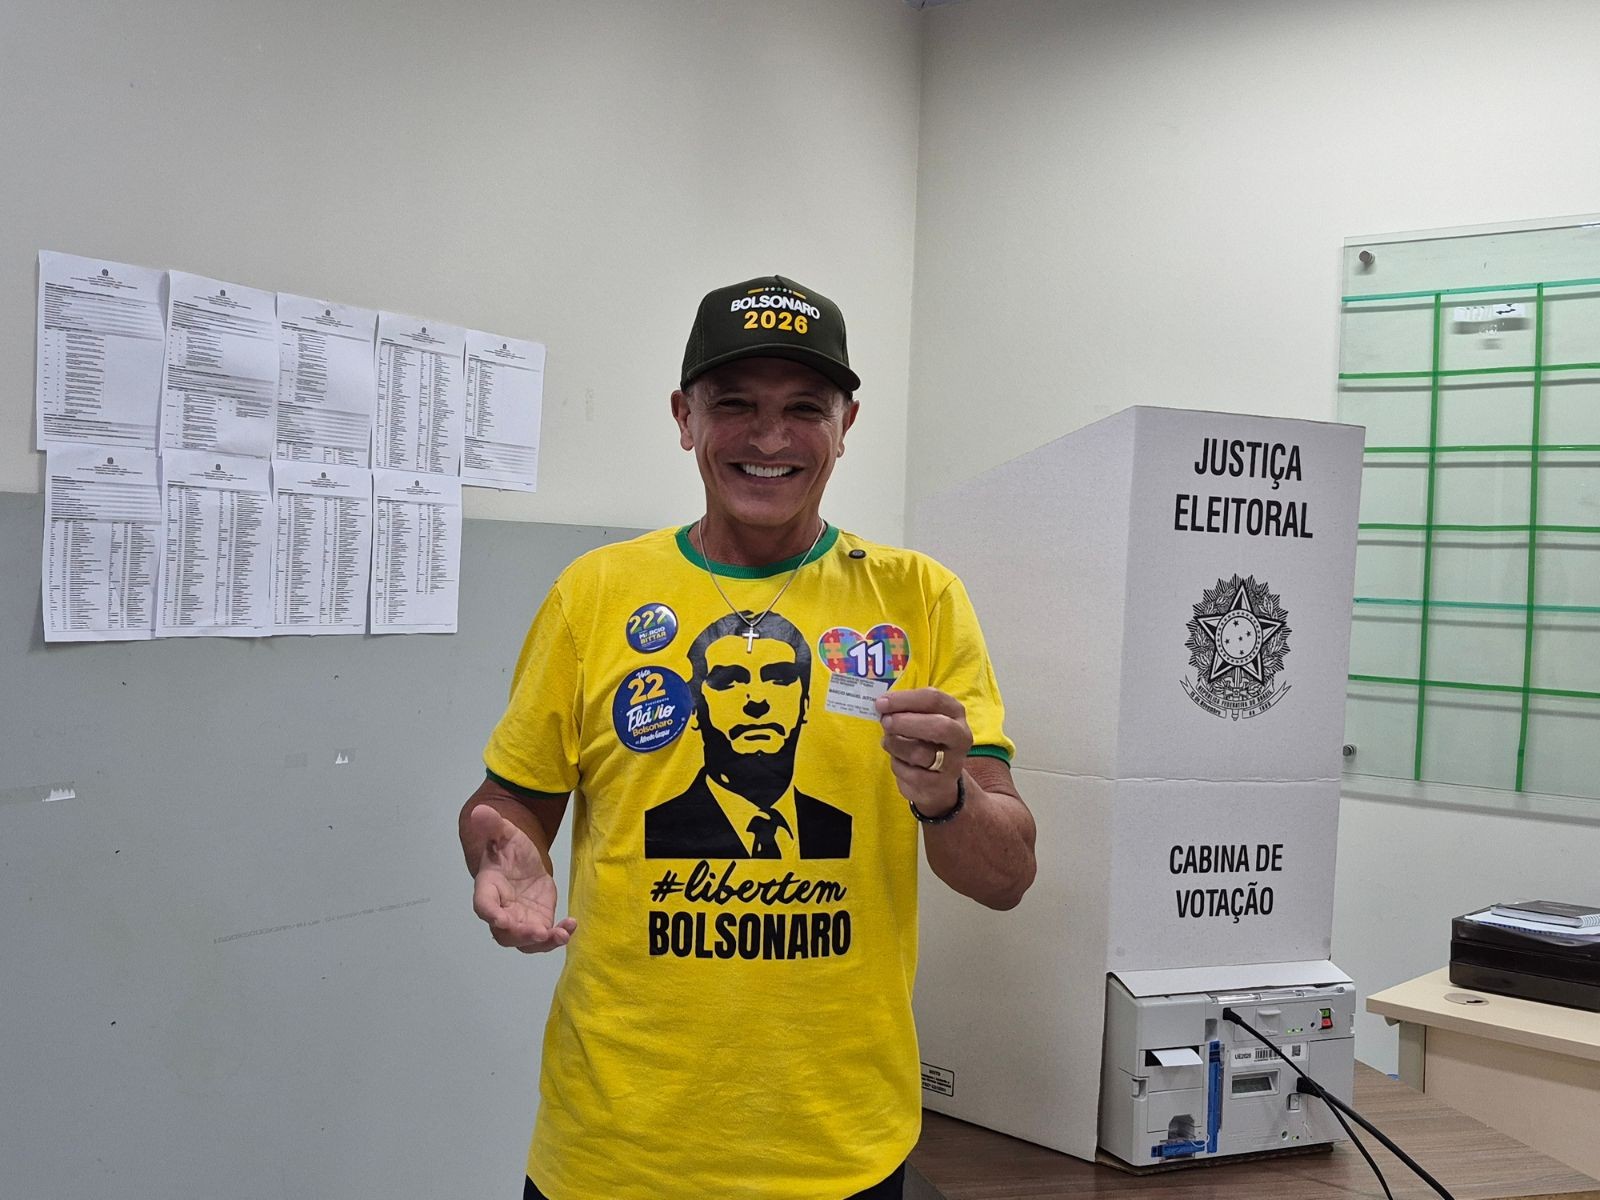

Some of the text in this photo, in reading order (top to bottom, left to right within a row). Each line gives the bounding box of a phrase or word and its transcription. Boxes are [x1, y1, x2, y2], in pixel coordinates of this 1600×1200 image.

[730, 295, 820, 319] BOLSONARO
[744, 310, 808, 334] 2026
[1194, 438, 1302, 490] JUSTIÇA
[1174, 494, 1313, 539] ELEITORAL
[848, 640, 885, 677] 11
[627, 673, 666, 706] 22
[626, 704, 676, 732] Flávio
[632, 719, 673, 737] Bolsonaro
[1169, 844, 1284, 874] CABINA DE
[650, 860, 847, 906] #libertem
[1176, 881, 1274, 924] VOTAÇÃO
[649, 910, 851, 960] BOLSONARO
